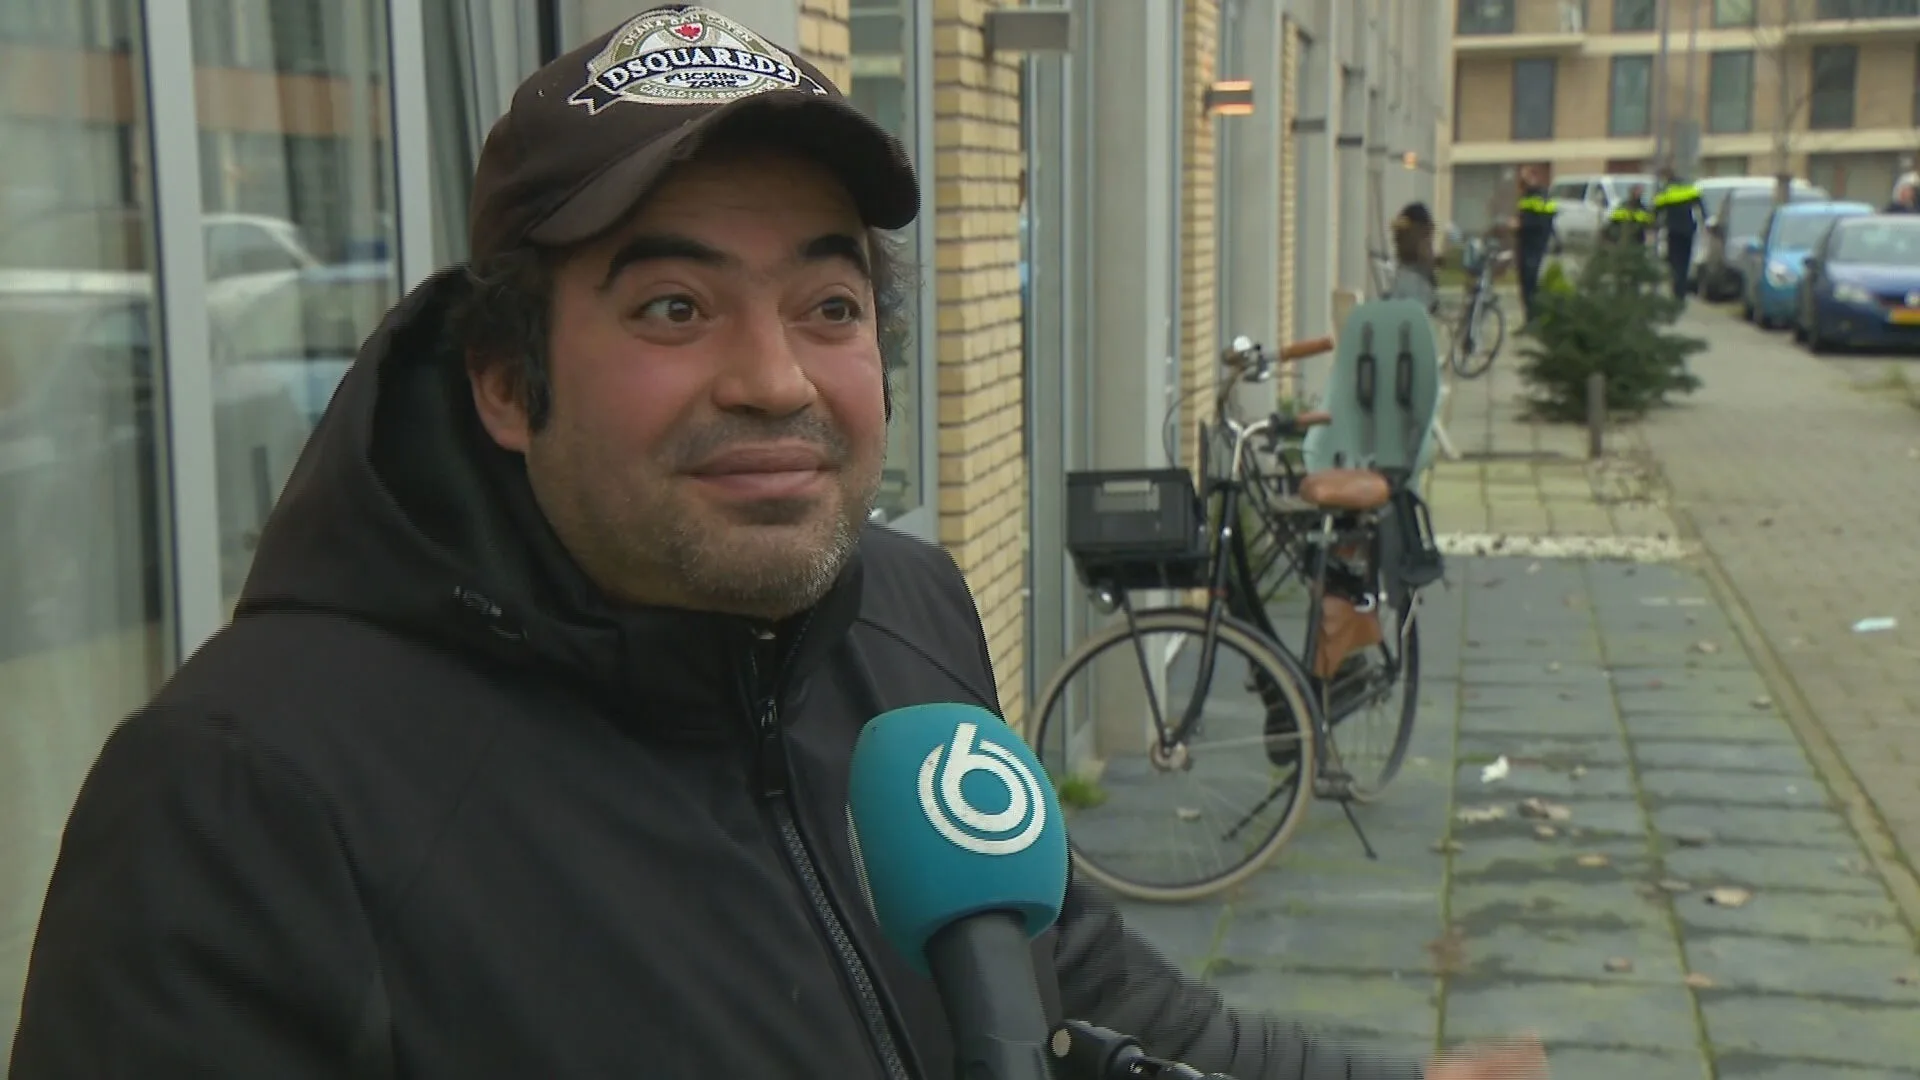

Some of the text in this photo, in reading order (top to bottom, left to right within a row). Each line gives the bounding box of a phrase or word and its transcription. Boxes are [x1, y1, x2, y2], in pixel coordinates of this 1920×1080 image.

[603, 47, 793, 88] DSQUARED2
[664, 72, 748, 84] FUCKING
[685, 80, 739, 89] ZONE
[640, 84, 713, 99] CANADIAN
